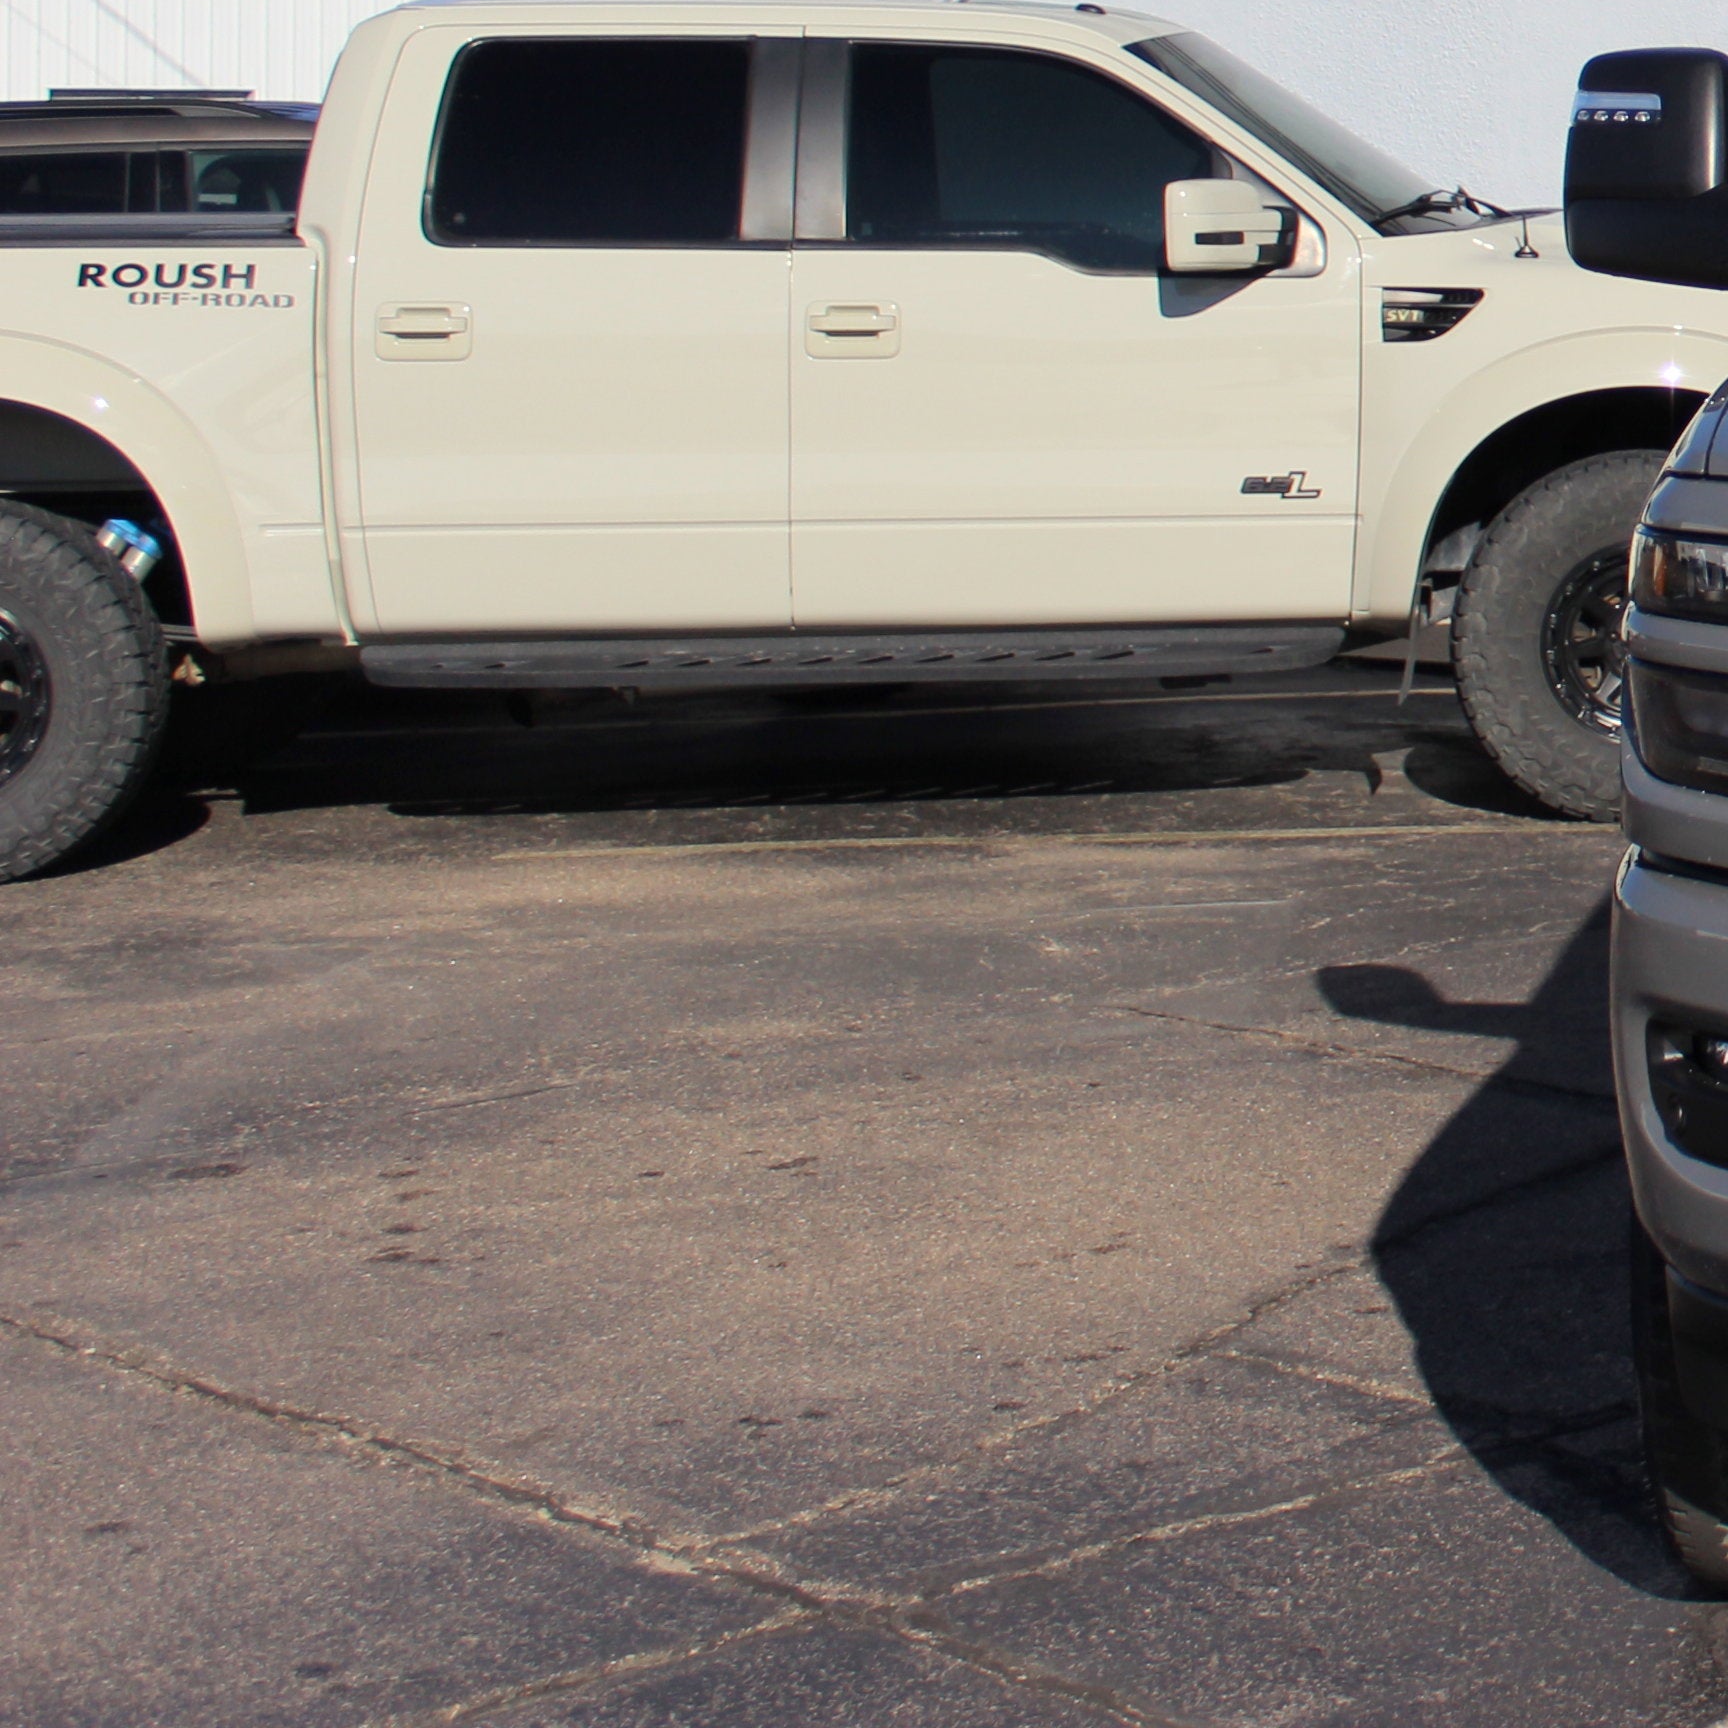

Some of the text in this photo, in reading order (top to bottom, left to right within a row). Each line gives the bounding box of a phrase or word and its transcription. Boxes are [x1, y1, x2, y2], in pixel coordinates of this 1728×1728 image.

[77, 262, 256, 290] ROUSH
[128, 291, 295, 309] OFF-ROAD
[1386, 309, 1420, 323] SVT
